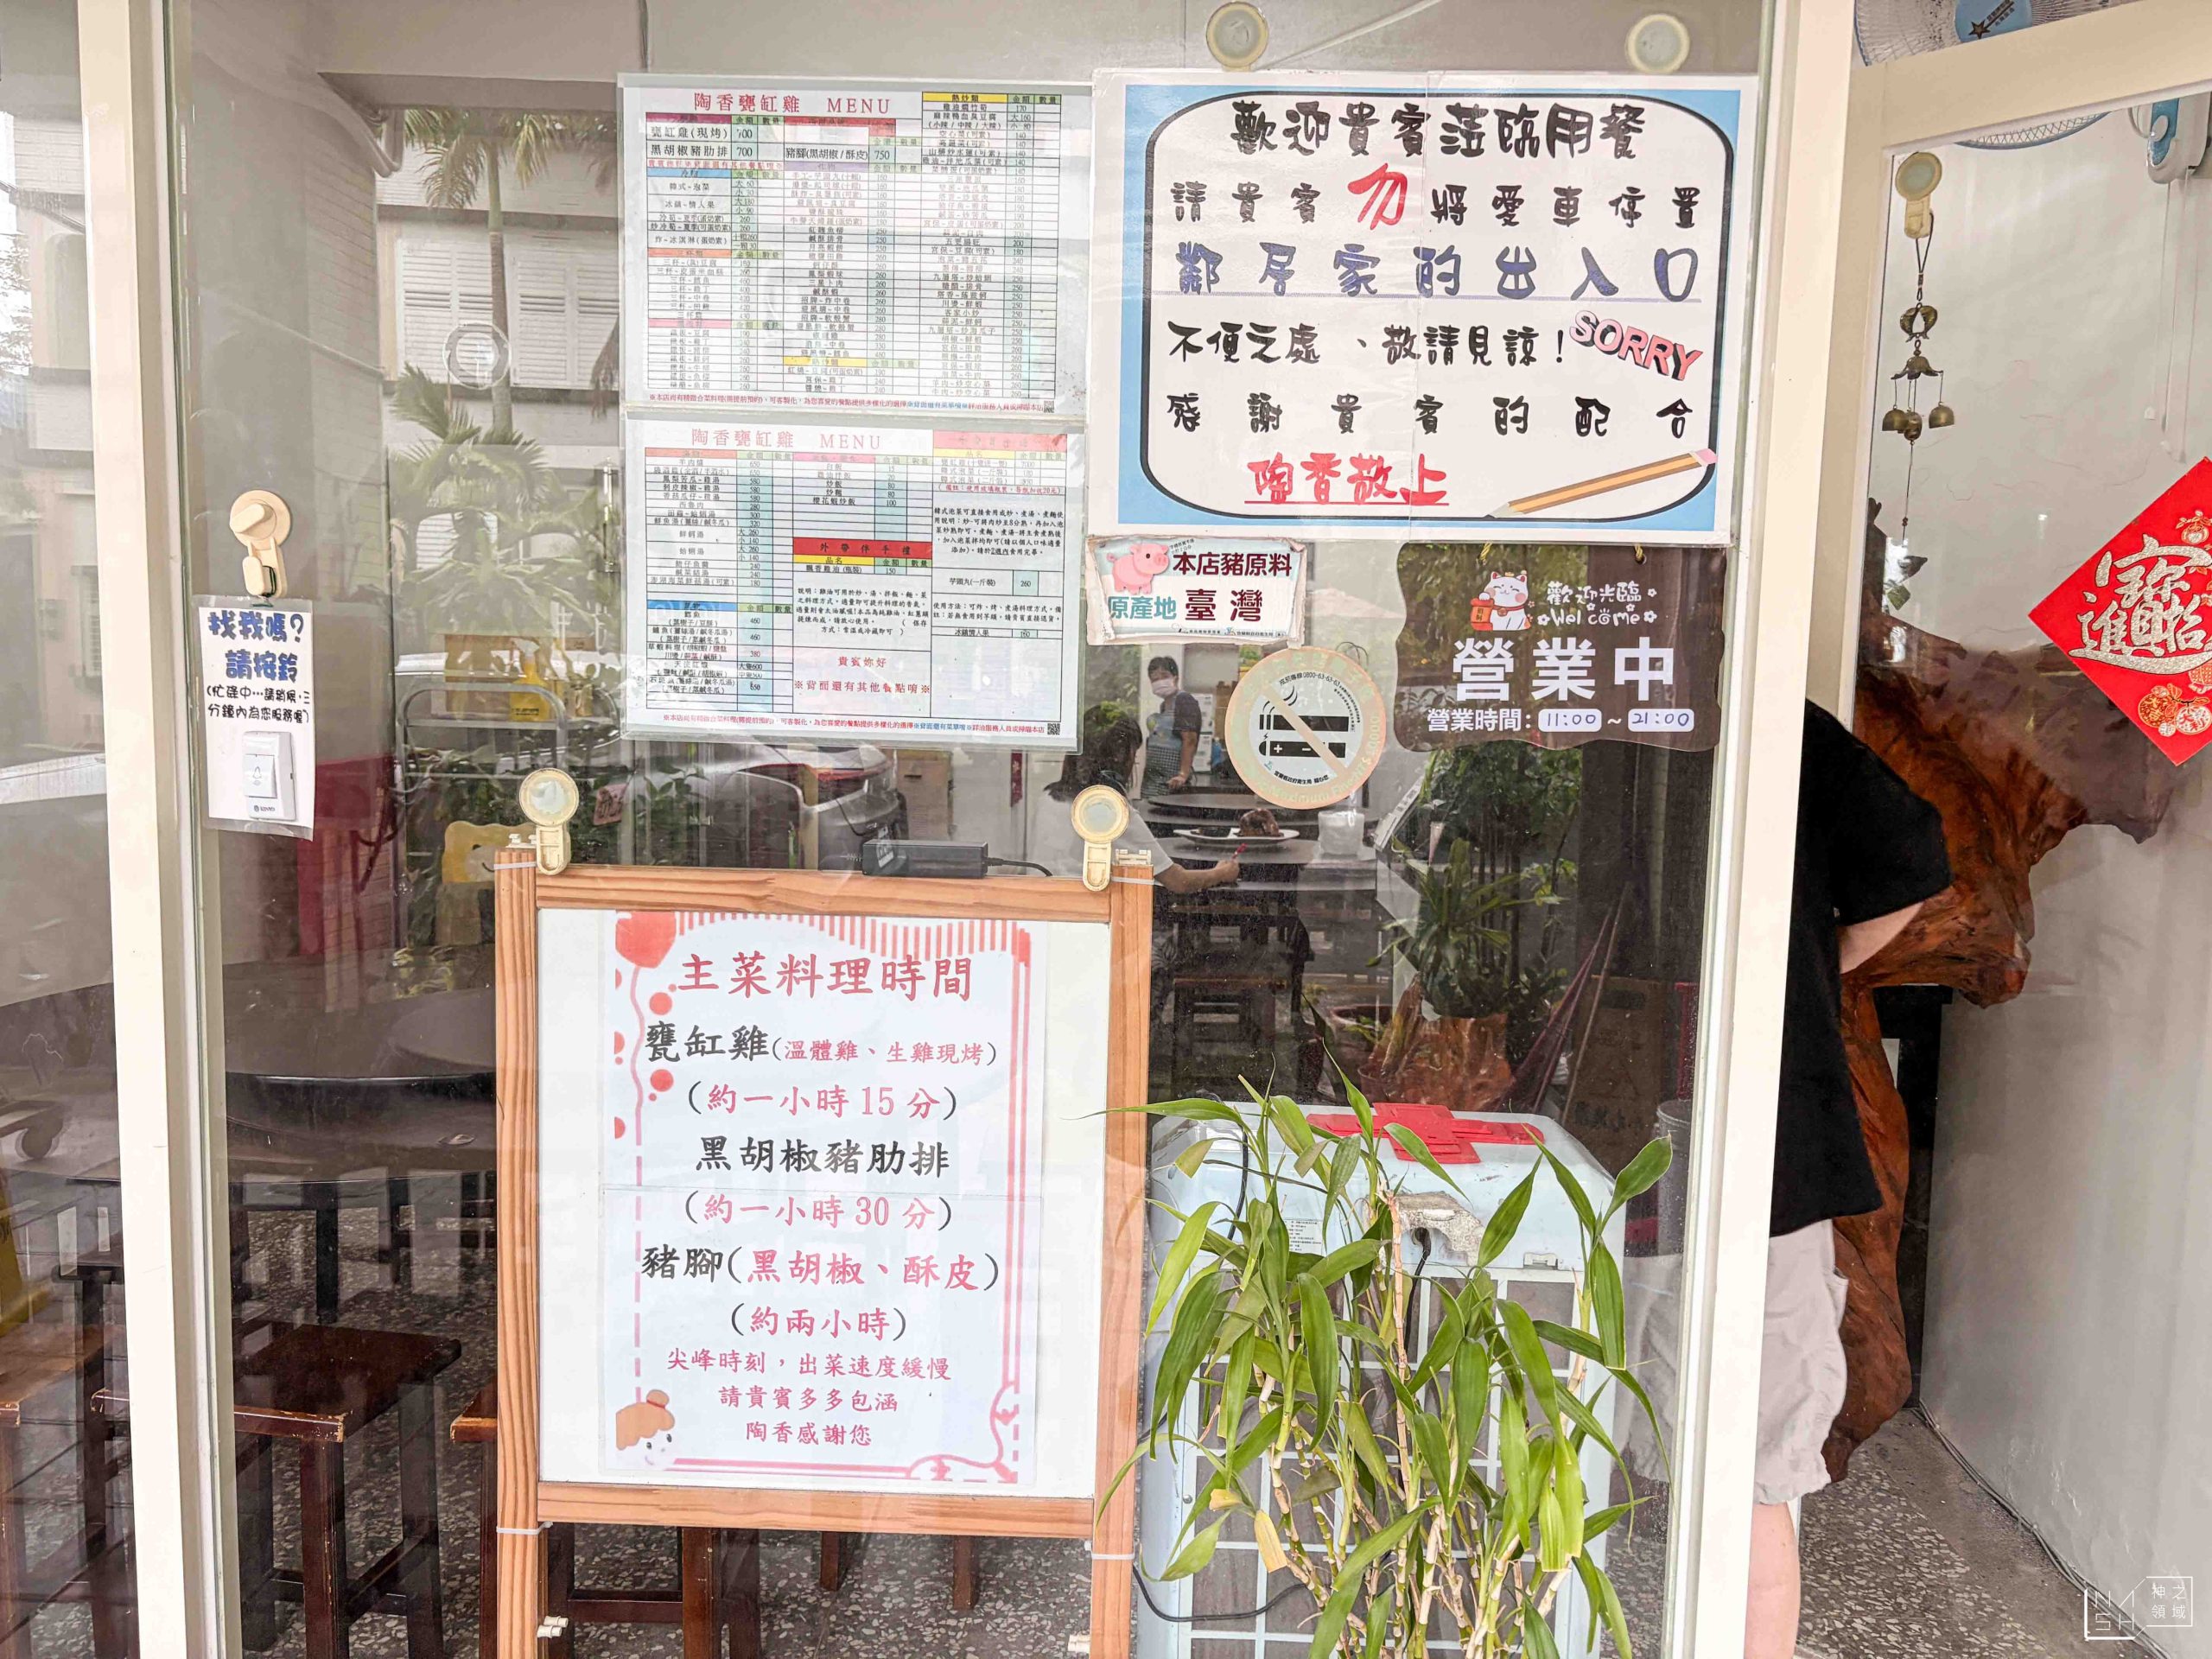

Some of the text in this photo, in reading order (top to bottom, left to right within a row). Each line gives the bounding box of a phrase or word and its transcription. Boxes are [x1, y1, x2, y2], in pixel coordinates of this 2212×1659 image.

[694, 93, 892, 114] 陶香甕缸雞 MENU
[737, 129, 752, 138] 700
[1231, 100, 1645, 160] 歡迎貴賓蒞臨用餐
[652, 144, 752, 157] 黑胡椒豬肋排 700
[874, 150, 889, 160] 750
[1177, 241, 1699, 302] 鄰居家的出入口
[1568, 310, 1704, 381] SORRY
[1166, 394, 1694, 437] 感謝貴賓的配合
[692, 429, 881, 449] 陶香甕缸雞 MENU
[1249, 453, 1448, 505] 陶香敬上
[1173, 551, 1292, 576] 本店豬原料
[1108, 589, 1262, 621] 原產地 臺灣
[1547, 581, 1642, 605] 歡迎光臨
[225, 650, 298, 683] 請按鈴
[837, 656, 887, 668] 貴賓妳好
[1452, 637, 1675, 702] 營業中
[1544, 714, 1597, 728] 11:00
[1633, 713, 1691, 728] 21:00
[678, 950, 973, 1001] 主菜料理時間
[696, 1135, 950, 1176] 黑胡椒豬肋排
[731, 1303, 908, 1341] (約兩小時)
[719, 1385, 899, 1413] 請貴賓多多包涵
[746, 1421, 873, 1446] 陶香感謝您
